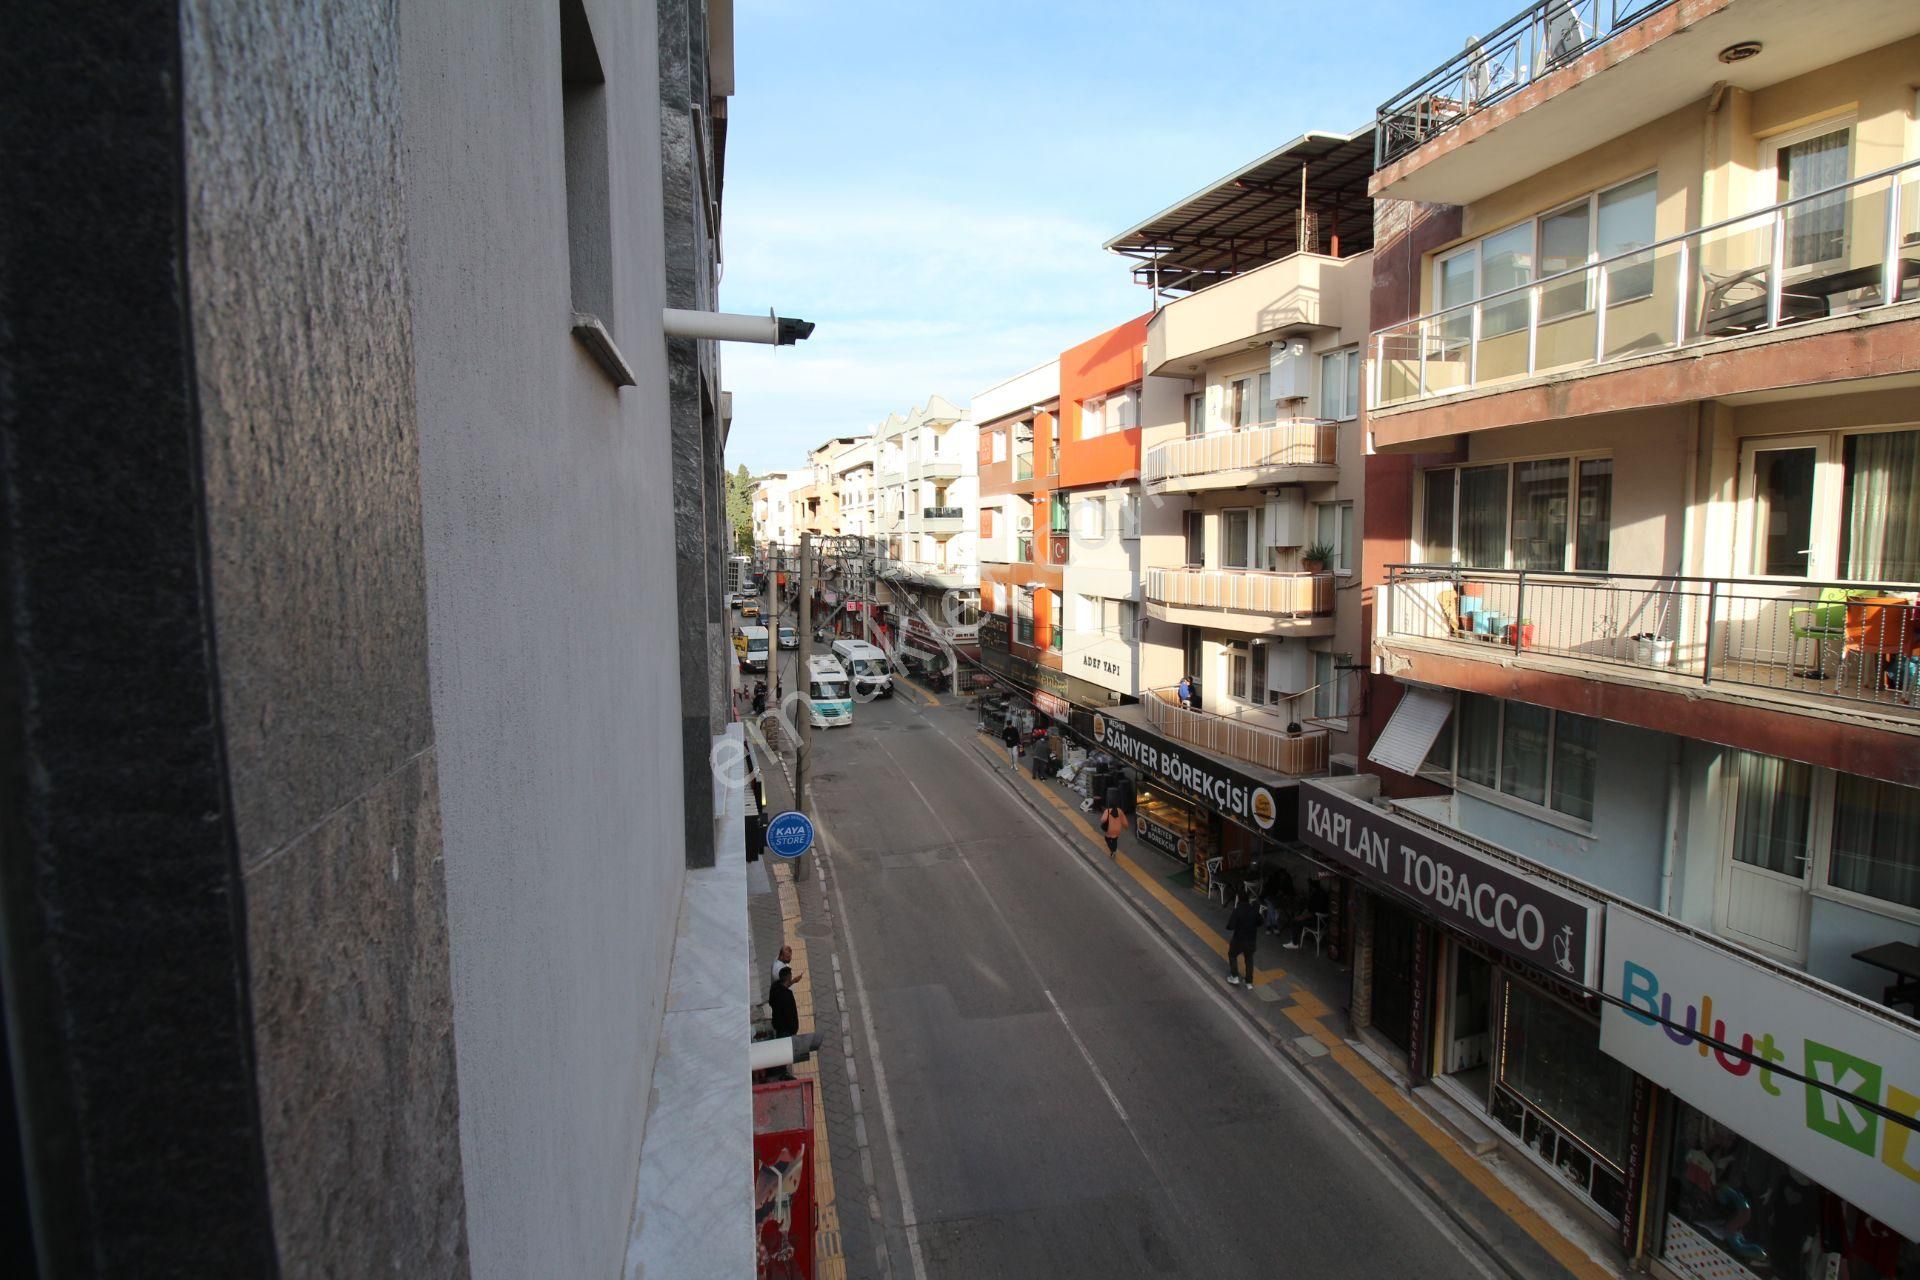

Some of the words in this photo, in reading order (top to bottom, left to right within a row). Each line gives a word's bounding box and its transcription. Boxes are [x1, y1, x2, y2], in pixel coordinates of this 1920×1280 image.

[1103, 660, 1121, 676] YAPI
[1106, 727, 1158, 771] SARIYER
[1161, 752, 1248, 818] BÖREKÇİSİ
[776, 826, 805, 836] KAYA
[776, 836, 805, 846] STORE
[1307, 800, 1390, 874] KAPLAN
[1400, 845, 1545, 950] TOBACCO
[1621, 960, 1785, 1097] Bulut
